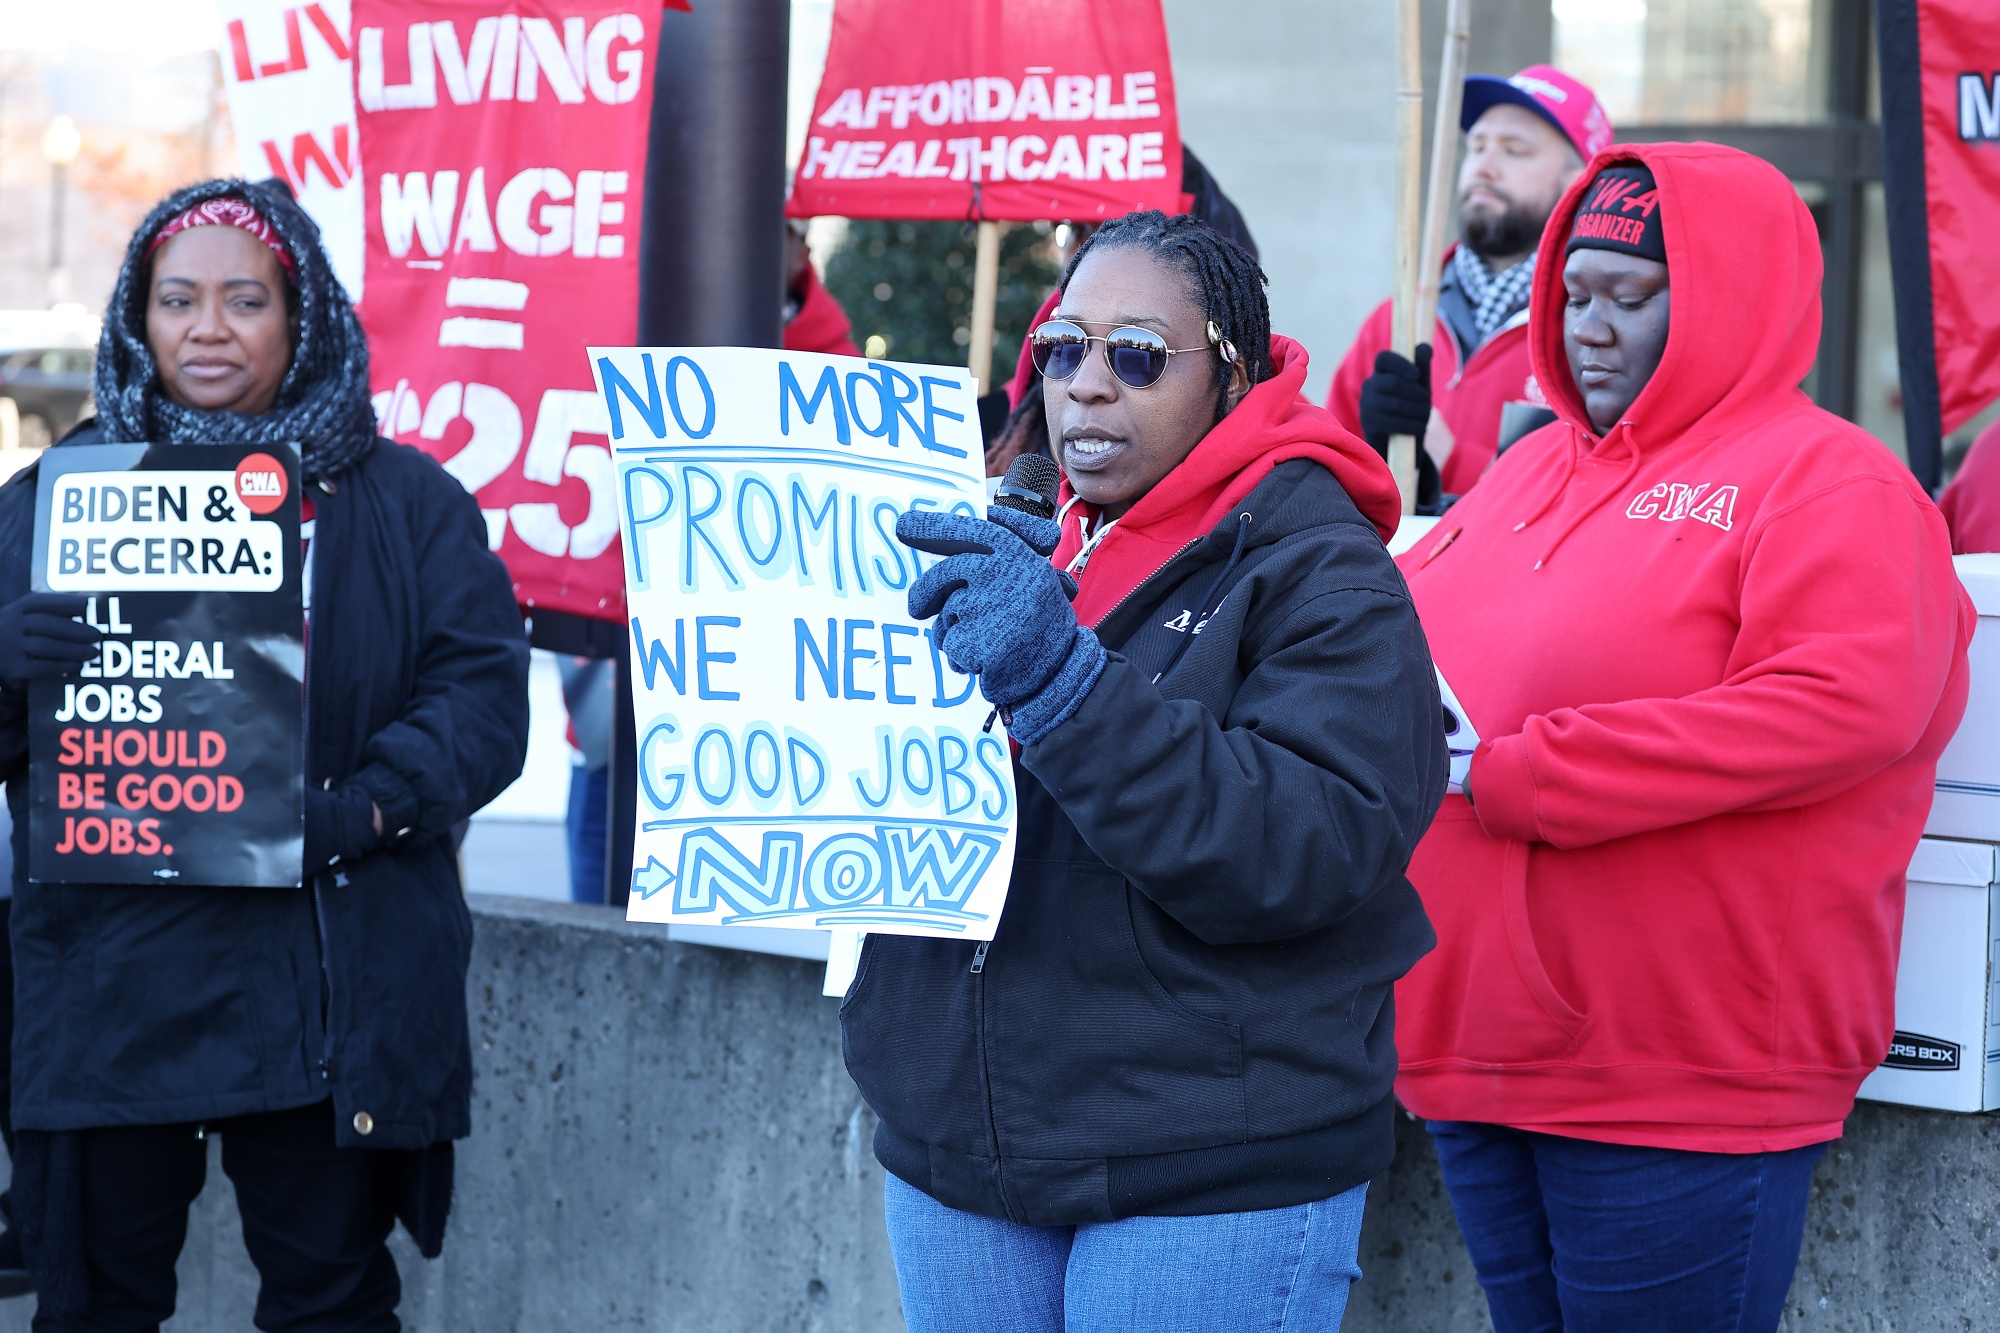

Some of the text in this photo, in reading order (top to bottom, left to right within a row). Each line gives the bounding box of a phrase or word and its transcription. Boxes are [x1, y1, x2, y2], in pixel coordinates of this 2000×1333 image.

[358, 13, 645, 113] LIVING
[802, 131, 1167, 181] HEALTHCARE
[380, 166, 628, 258] WAGE
[1582, 177, 1659, 218] WA
[597, 353, 968, 459] NO MORE
[62, 486, 236, 523] BIDEN &
[240, 472, 281, 496] CWA
[1626, 482, 1739, 531] CWA
[624, 467, 976, 594] PROMIS
[59, 538, 273, 575] BECERRA:
[71, 597, 132, 634] LL
[632, 616, 977, 709] WE NEED
[54, 684, 163, 723] JOBS
[58, 729, 227, 767] SHOULD
[58, 773, 245, 812] BE GOOD
[640, 723, 1008, 822] GOOD JOBS
[55, 818, 174, 856] JOBS.
[672, 826, 1001, 916] NOW
[1918, 1047, 1953, 1062] BOX
